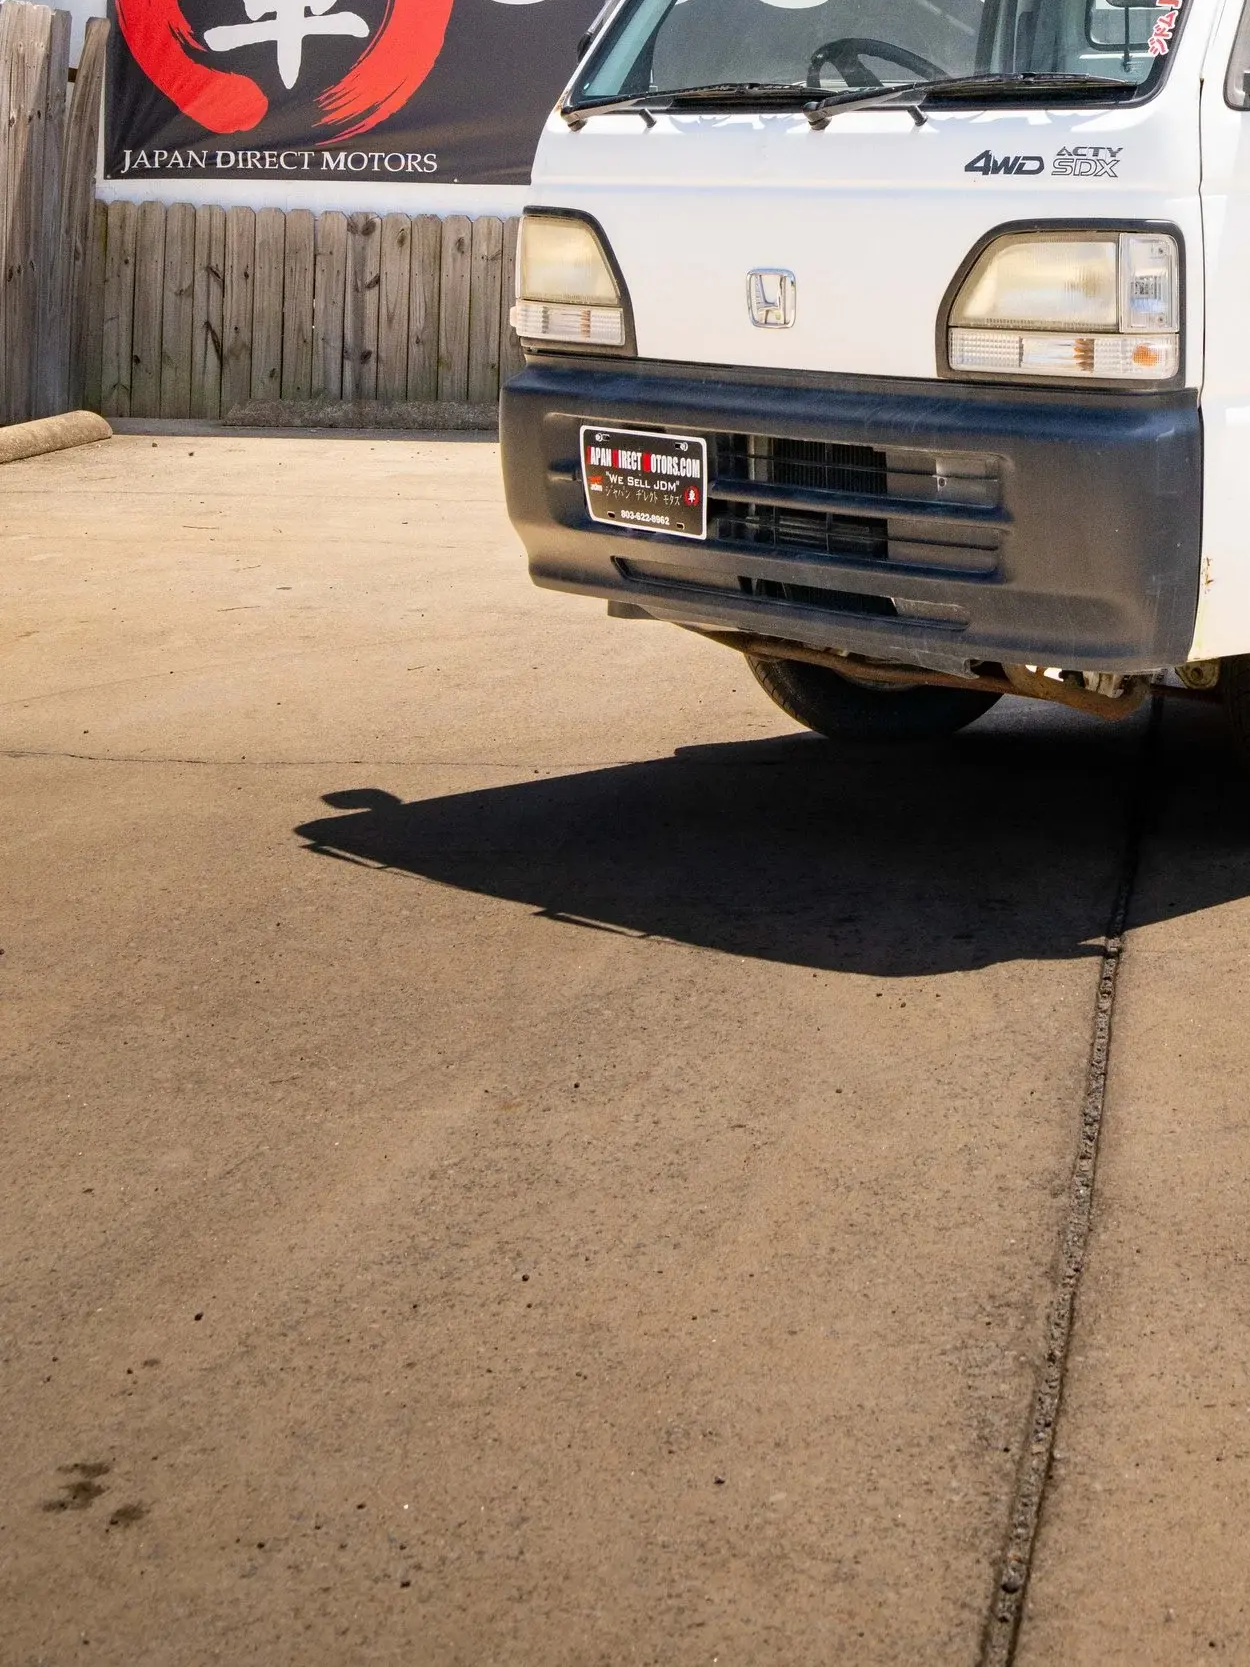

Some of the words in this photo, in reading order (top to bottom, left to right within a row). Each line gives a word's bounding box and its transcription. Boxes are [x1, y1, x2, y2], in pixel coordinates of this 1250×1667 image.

[121, 149, 209, 174] JAPAN
[215, 150, 315, 171] DIRECT
[321, 151, 438, 173] MOTORS
[964, 149, 1045, 176] 4WD
[1056, 146, 1124, 158] ACTY
[1051, 158, 1119, 178] SDX
